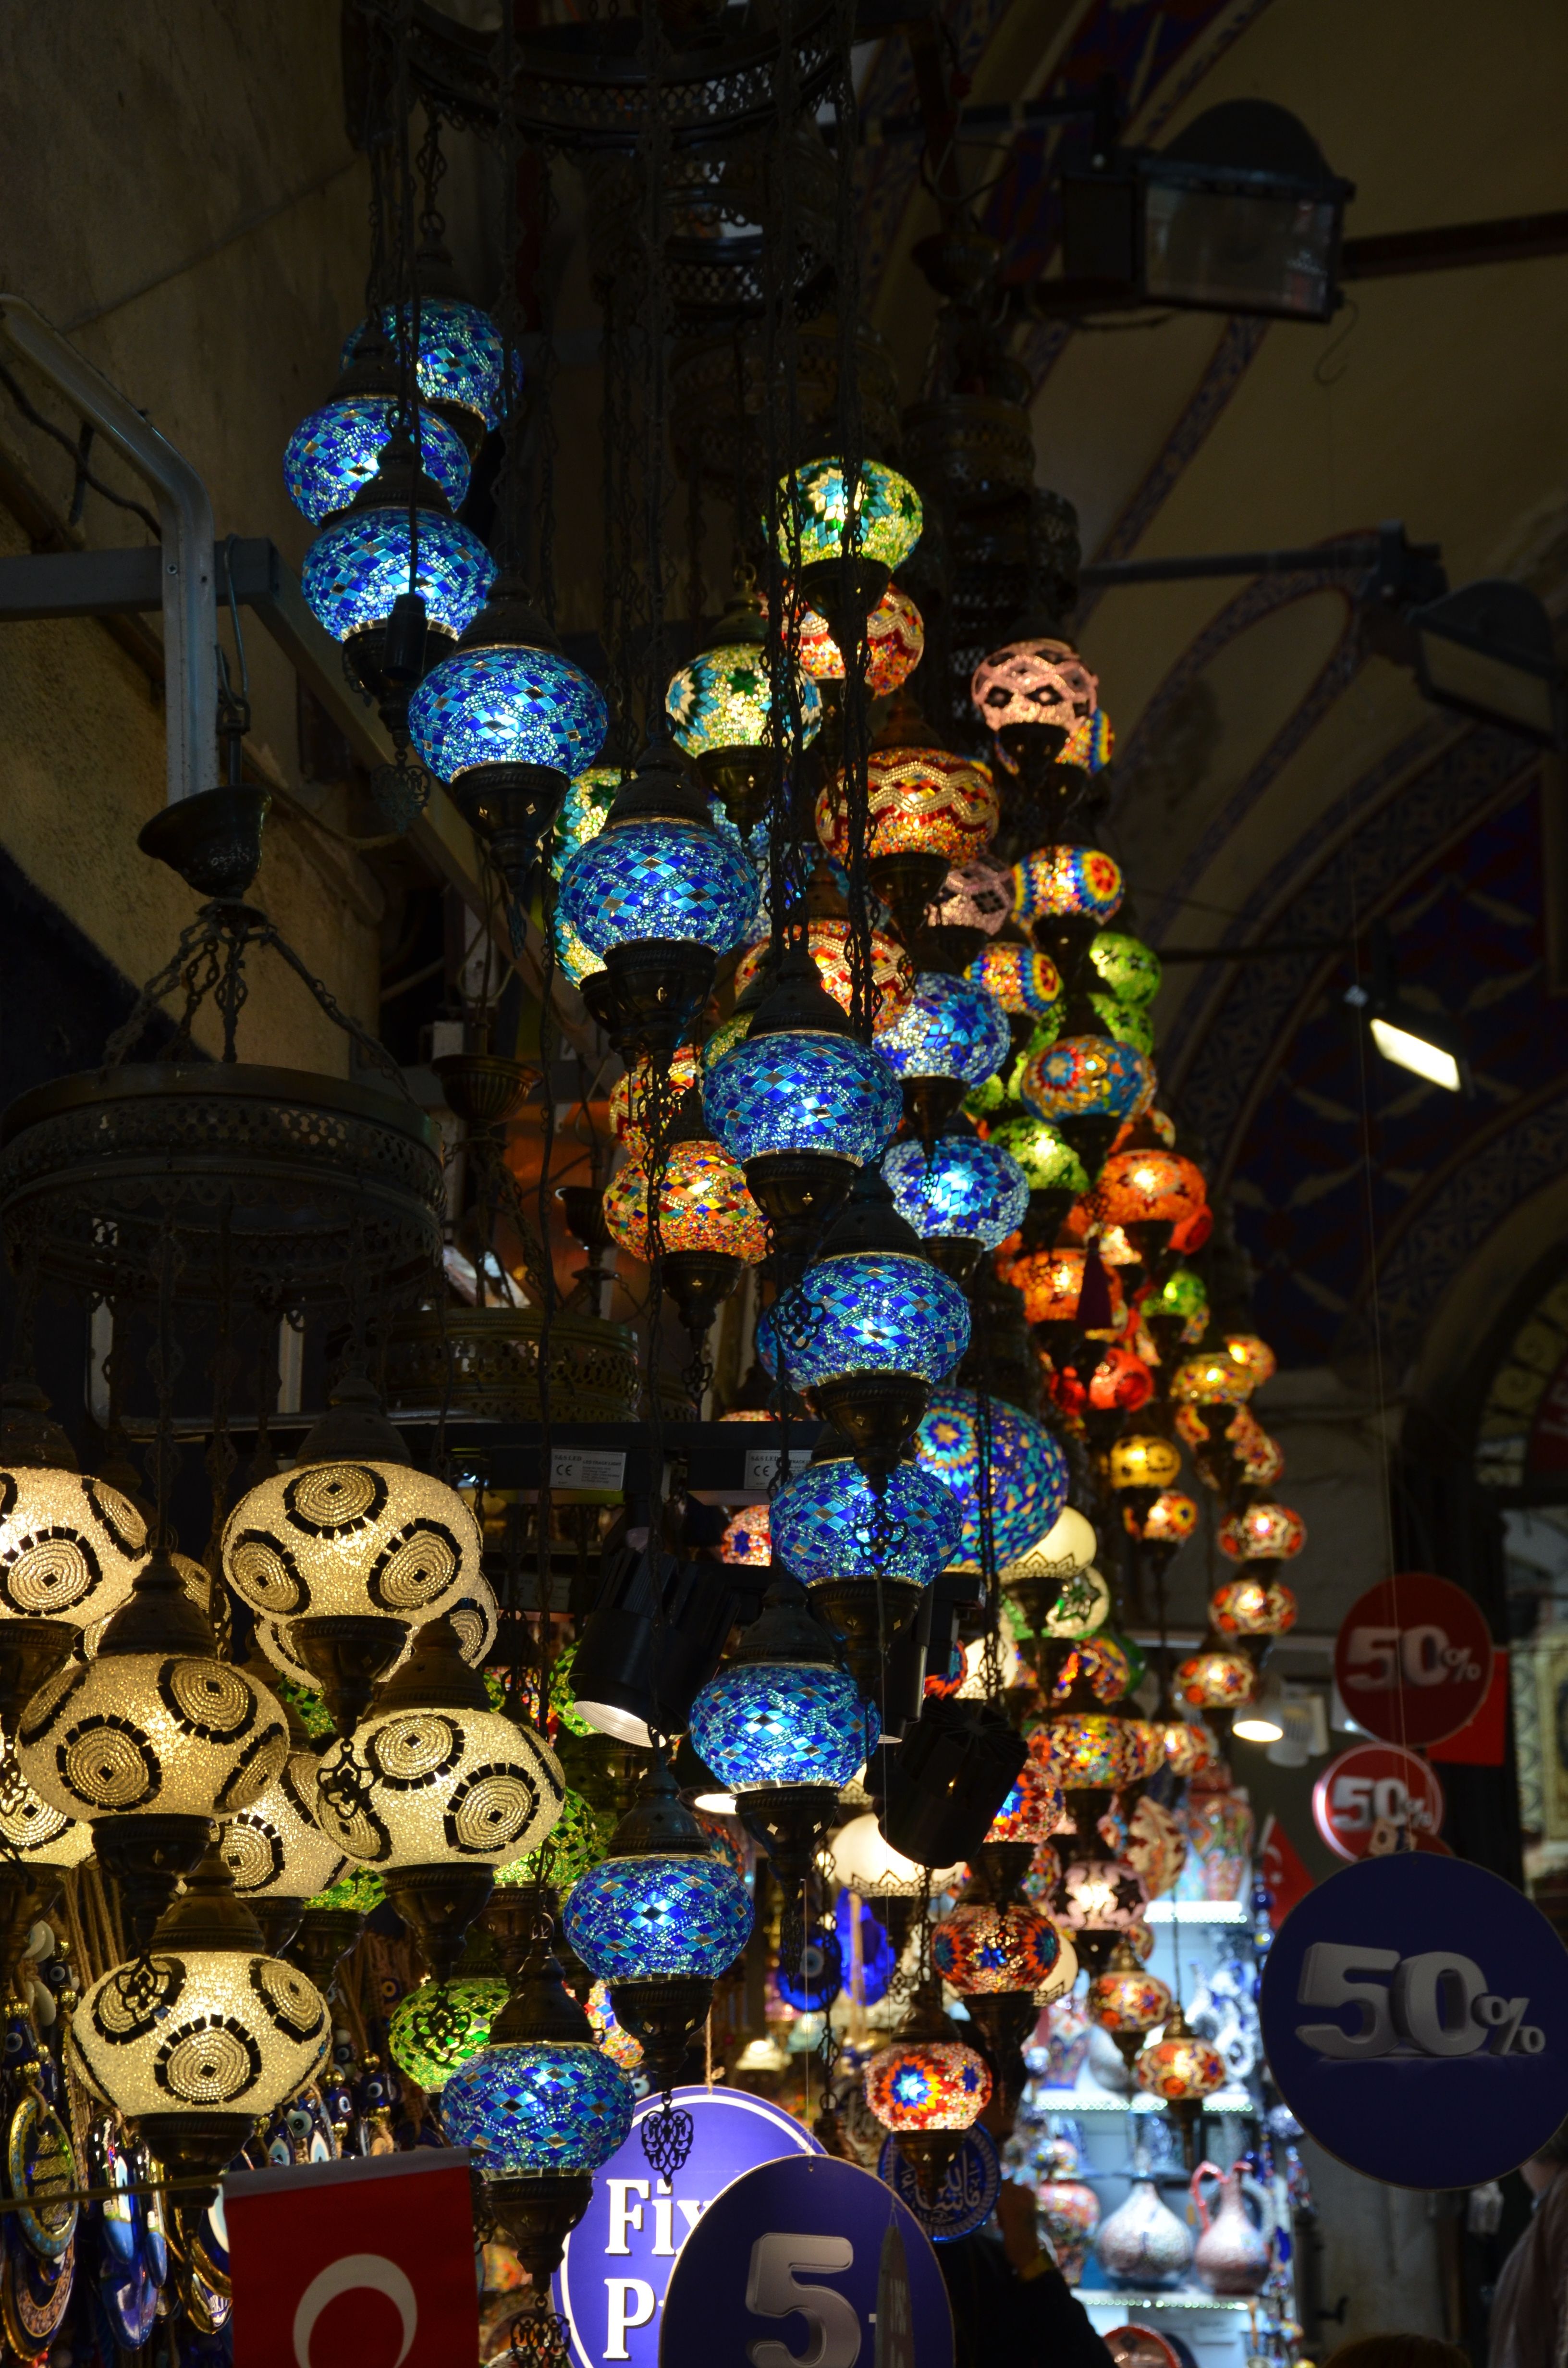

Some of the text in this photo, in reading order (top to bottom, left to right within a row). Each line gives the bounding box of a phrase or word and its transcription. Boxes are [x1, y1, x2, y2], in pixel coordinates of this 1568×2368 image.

[556, 1464, 573, 1476] CE
[754, 1465, 770, 1477] CE
[1345, 1623, 1482, 1691] 50%
[1331, 1775, 1433, 1832] 50%
[1295, 1942, 1546, 2059] 50%
[602, 2278, 665, 2359] P
